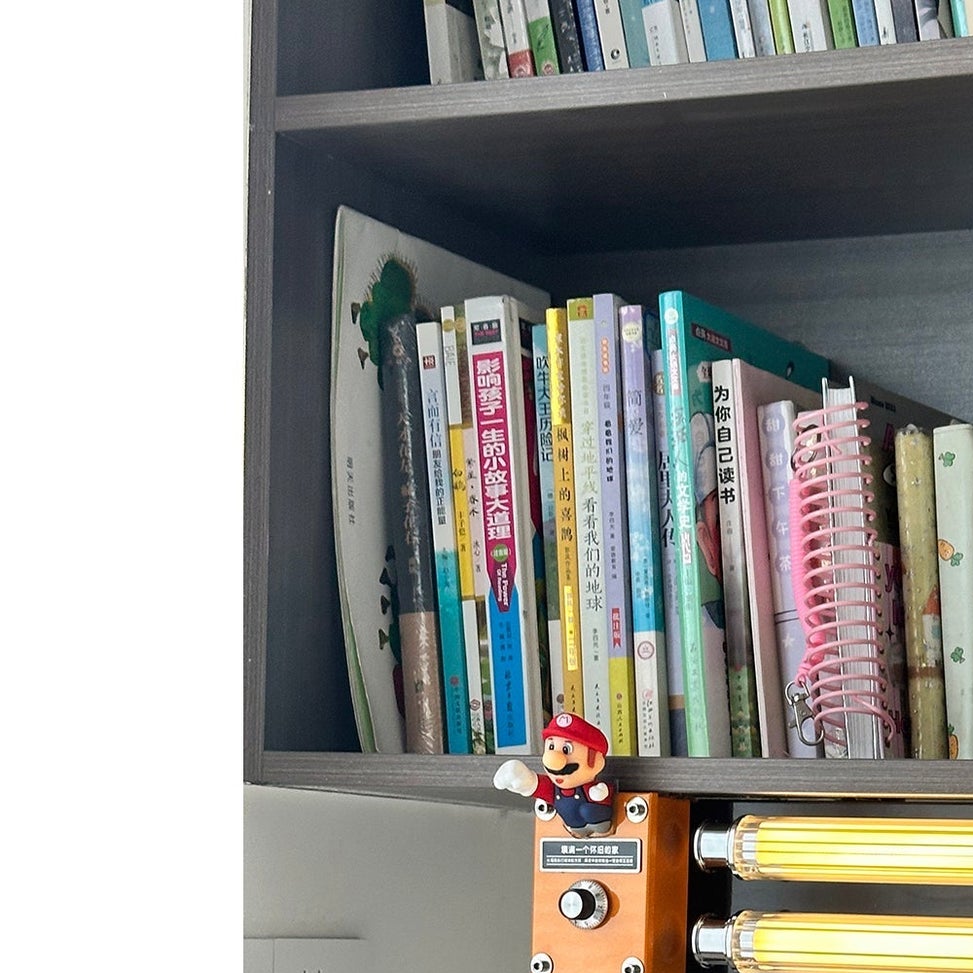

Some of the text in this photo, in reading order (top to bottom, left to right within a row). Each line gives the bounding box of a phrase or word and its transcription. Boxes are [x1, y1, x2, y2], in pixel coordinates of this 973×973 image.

[476, 357, 512, 540] 影响孩子一生的小故事大道理
[536, 355, 553, 462] 吹牛大王历险记
[714, 385, 736, 504] 为你自己读书
[556, 427, 573, 542] 枫树上的喜鹊
[502, 580, 510, 607] Power
